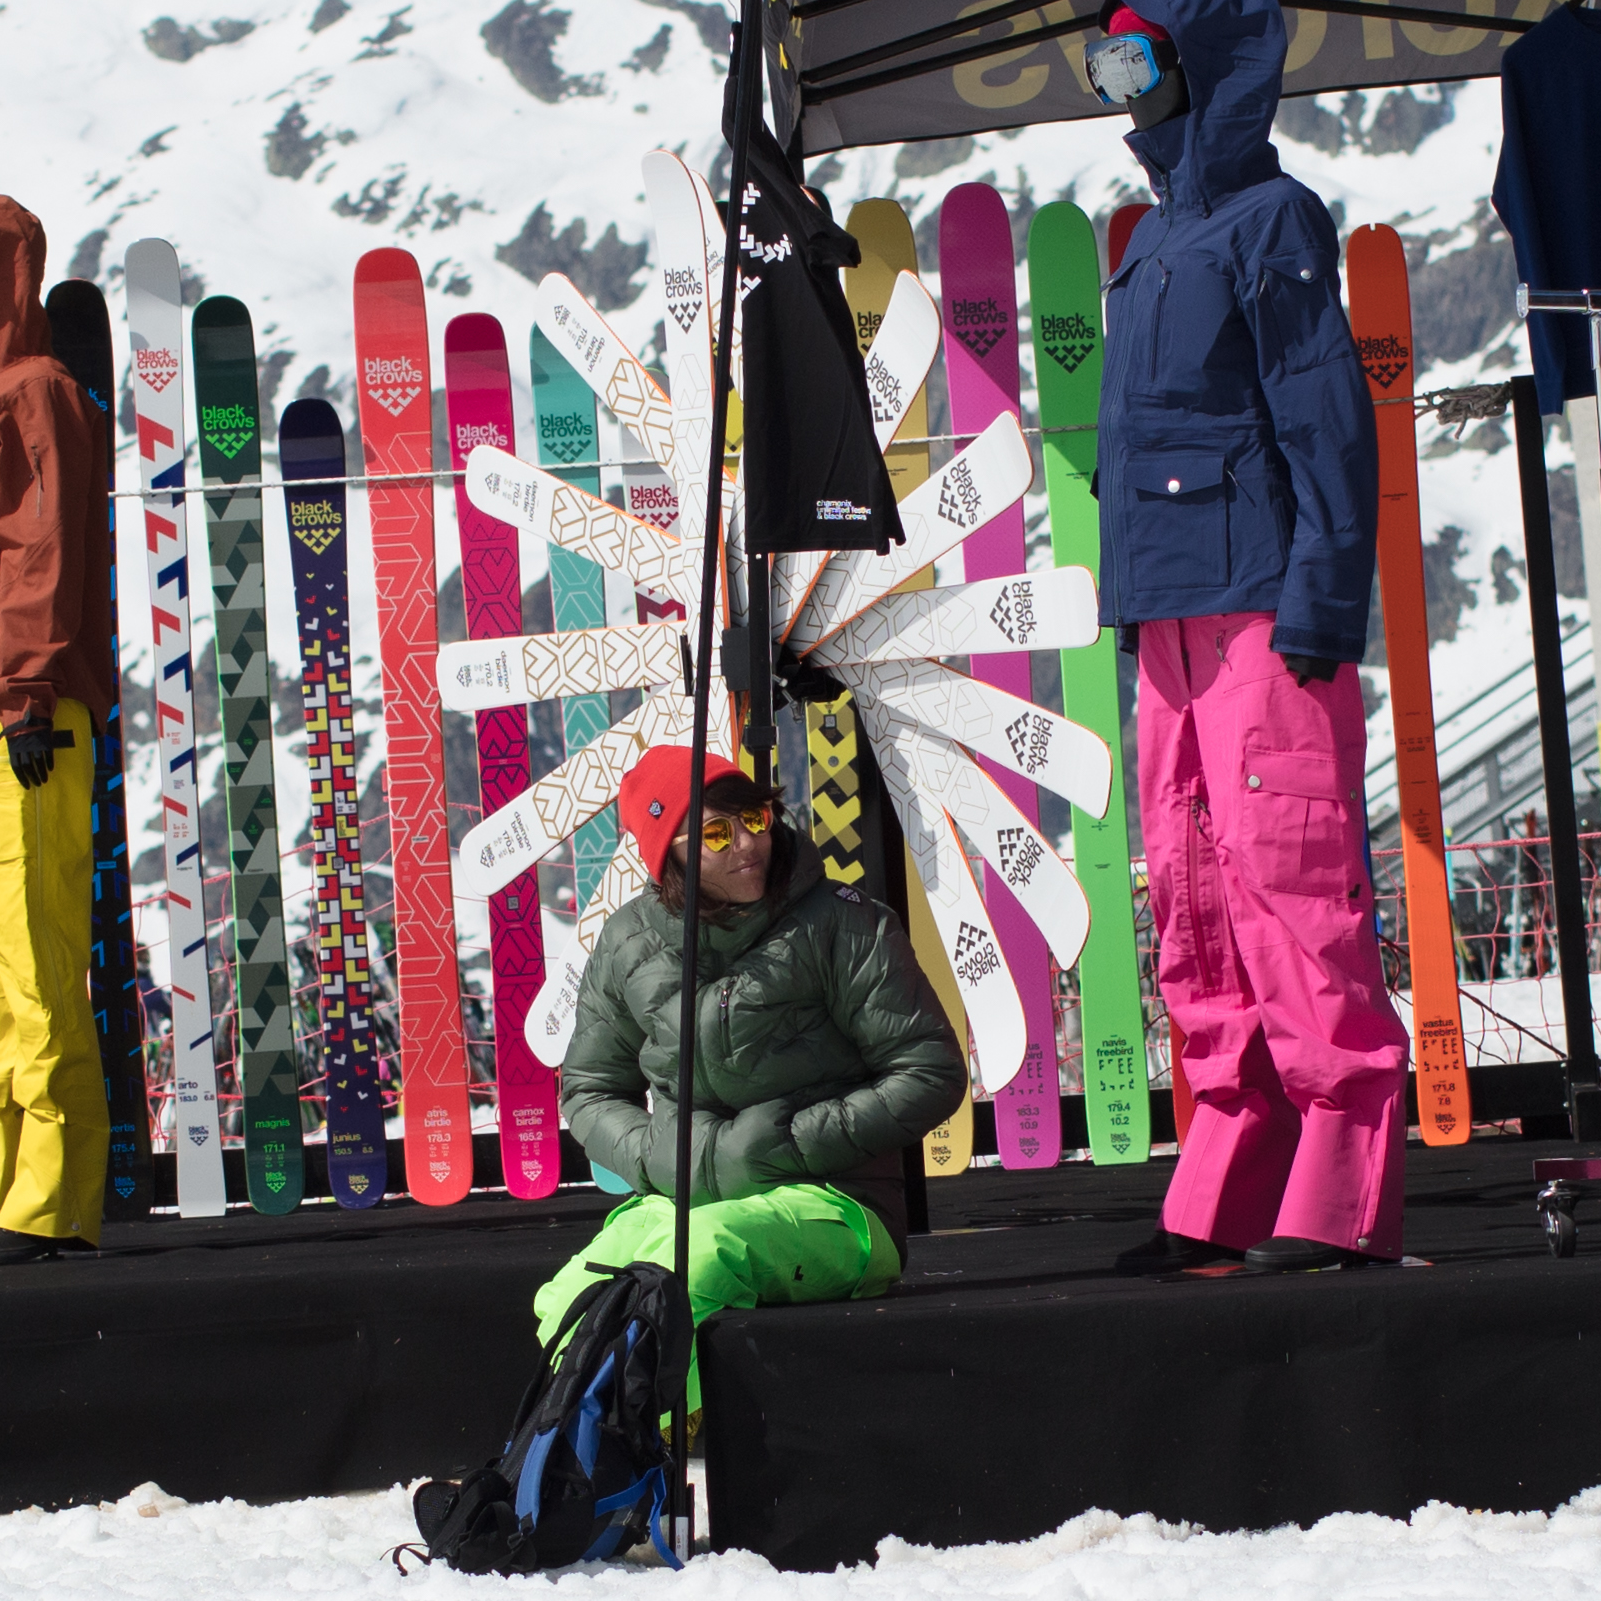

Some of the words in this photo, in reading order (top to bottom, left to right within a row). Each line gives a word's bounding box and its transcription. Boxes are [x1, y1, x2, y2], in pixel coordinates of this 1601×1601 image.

[664, 265, 695, 285] black
[665, 280, 702, 299] crows
[952, 297, 999, 316] black
[857, 309, 886, 328] bla
[953, 310, 1009, 327] crows
[1041, 313, 1086, 330] black
[1042, 325, 1096, 343] crows
[1357, 335, 1400, 351] black
[136, 347, 173, 363] black
[1359, 346, 1410, 362] crows
[137, 358, 179, 370] crows
[365, 355, 413, 373] black
[365, 369, 423, 386] crows
[869, 352, 902, 394] black
[865, 366, 903, 413] crows
[202, 404, 245, 420] black
[203, 415, 256, 431] crows
[540, 412, 582, 429] black
[456, 421, 500, 439] black
[541, 424, 593, 440] crows
[457, 434, 509, 449] crows
[956, 457, 982, 509] black
[630, 484, 672, 500] black
[949, 466, 979, 525] crows
[291, 500, 333, 516] black
[631, 495, 680, 510] crows
[291, 511, 342, 527] crows
[1011, 582, 1028, 645] crows
[1019, 580, 1038, 634] black
[1026, 714, 1043, 775] crows
[1035, 717, 1054, 769] black
[1007, 835, 1035, 887] crows
[1016, 841, 1045, 888] black
[956, 941, 994, 979] crows
[968, 952, 1001, 987] black
[1422, 1019, 1455, 1029] vastus
[1419, 1027, 1458, 1038] freebird
[1102, 1036, 1128, 1047] navis
[1096, 1046, 1135, 1057] freebird
[177, 1080, 199, 1090] arto
[1432, 1083, 1456, 1093] 171.8
[426, 1107, 448, 1118] atris
[512, 1108, 545, 1118] camox
[1107, 1102, 1132, 1112] 179.4
[255, 1117, 290, 1130] magnis
[424, 1116, 452, 1127] birdie
[515, 1116, 543, 1127] birdie
[1019, 1120, 1039, 1130] 10.9
[1110, 1116, 1130, 1126] 10.2
[331, 1131, 362, 1144] junius
[426, 1133, 451, 1144] 178.3
[518, 1131, 544, 1142] 165.2
[931, 1130, 950, 1140] 11.5
[263, 1143, 286, 1153] 171.1
